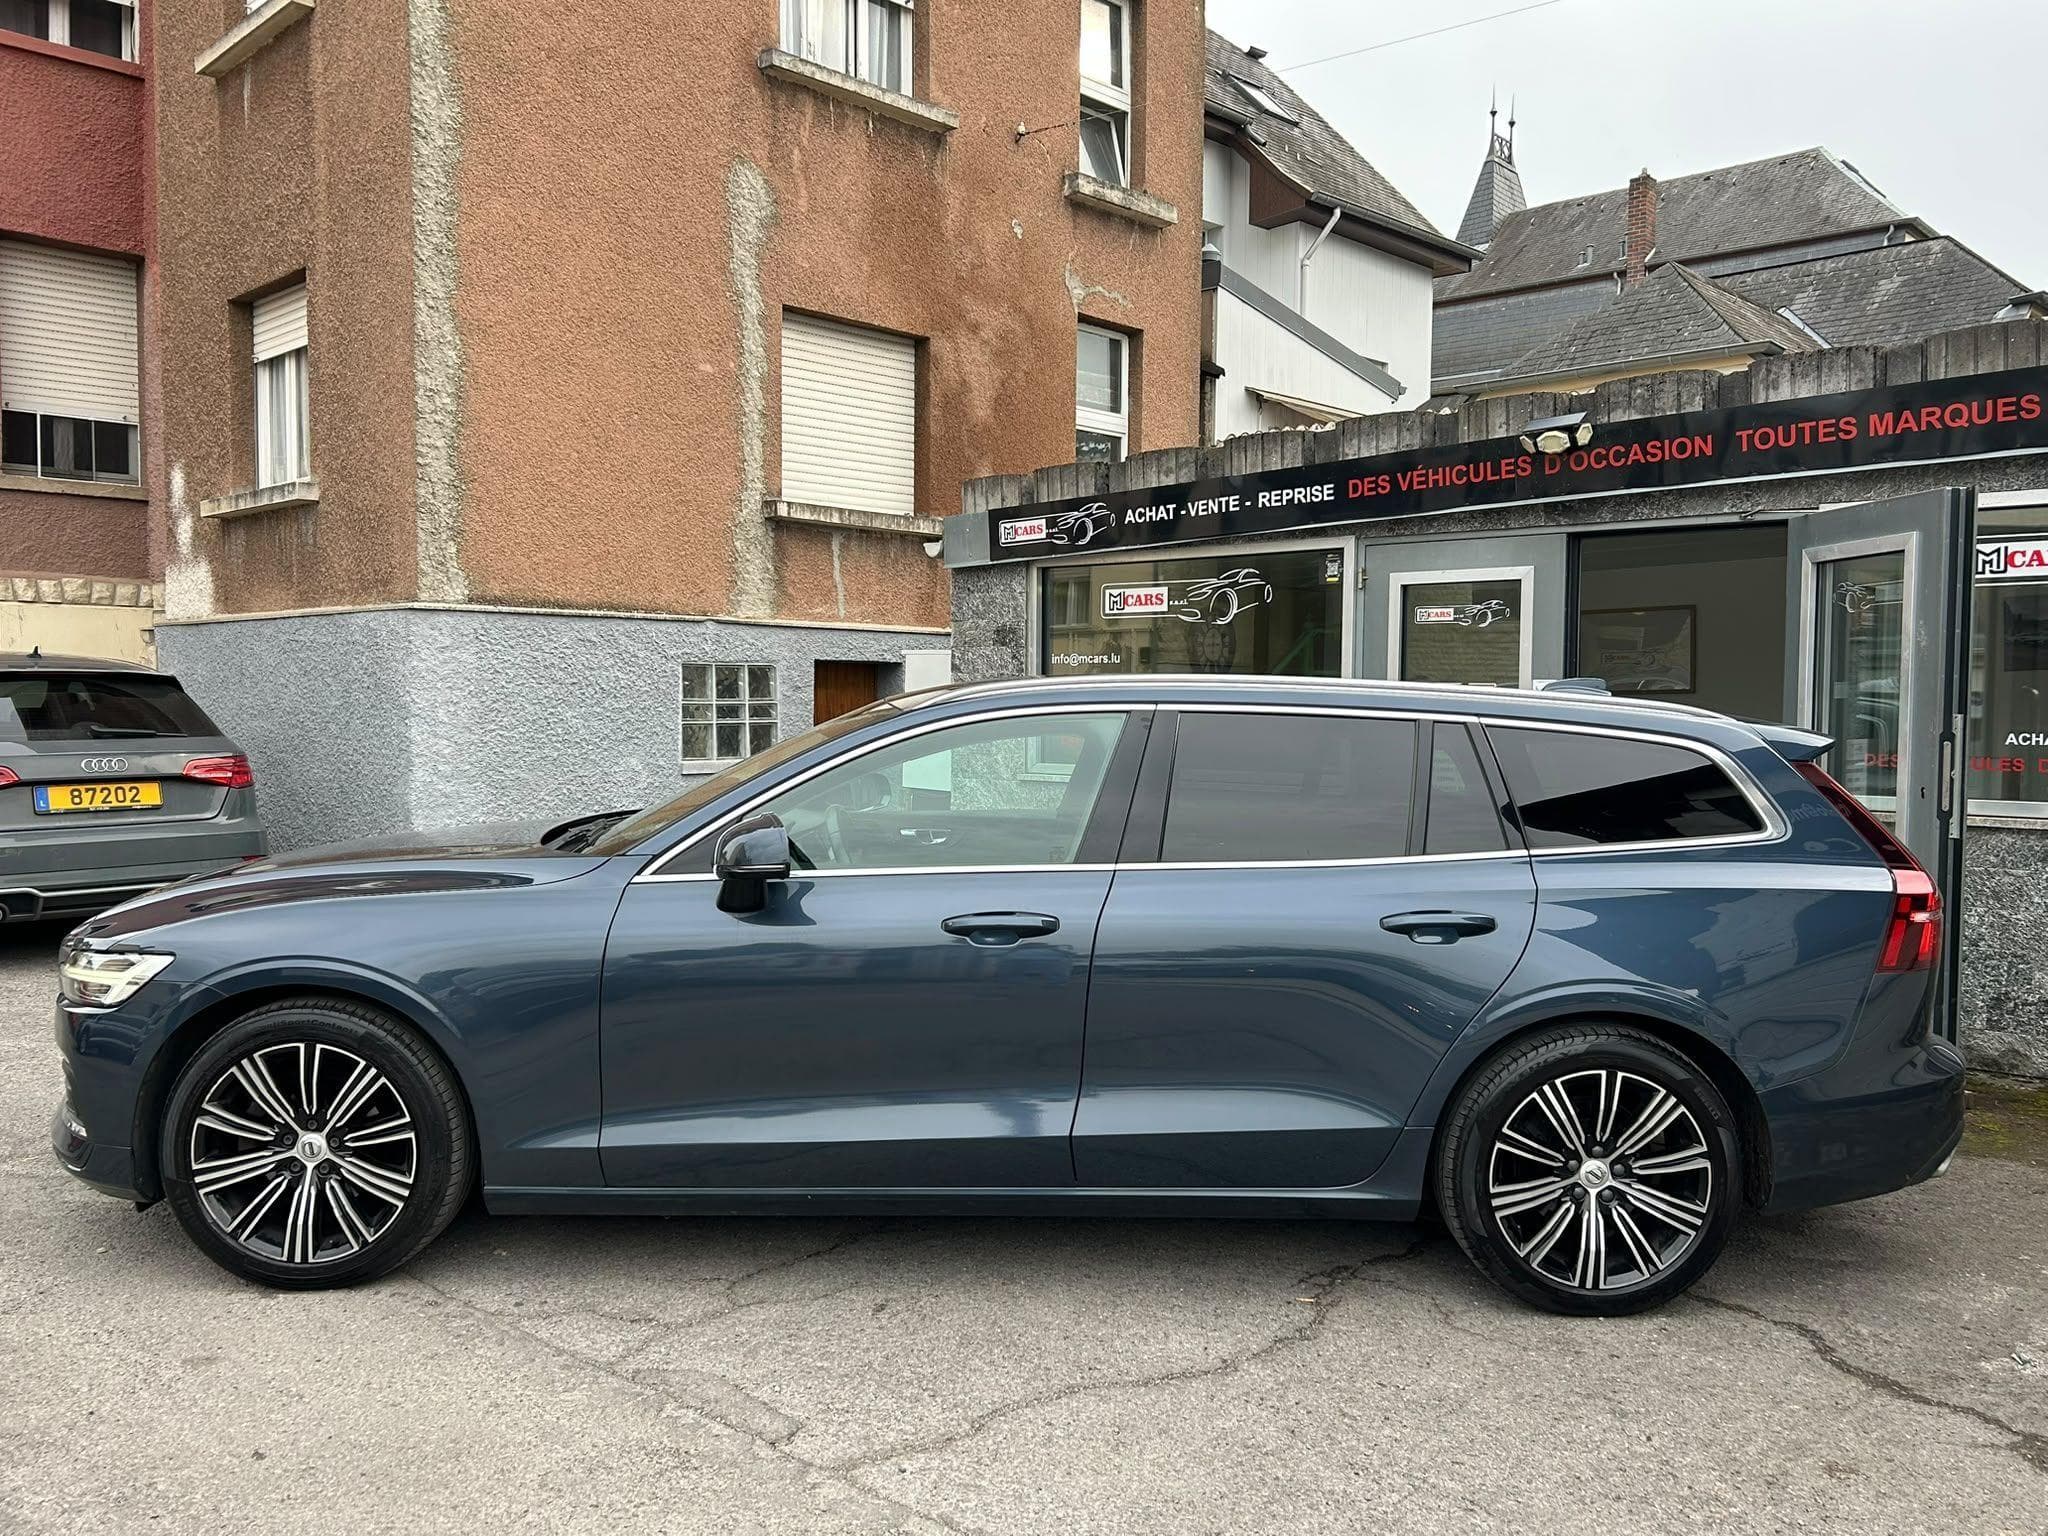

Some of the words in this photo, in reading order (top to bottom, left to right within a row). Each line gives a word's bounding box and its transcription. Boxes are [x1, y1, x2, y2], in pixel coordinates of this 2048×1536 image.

[1124, 504, 1177, 525] ACHAT
[1258, 484, 1335, 508] REPRISE
[1348, 475, 1391, 499] DES
[1397, 455, 1533, 491] VÉHICULES
[1544, 434, 1713, 475] D'OCCASION
[1735, 416, 1858, 452] TOUTES
[1868, 394, 2042, 437] MARQUES
[1051, 652, 1121, 667] info@mcars.lu
[69, 785, 142, 806] 87202
